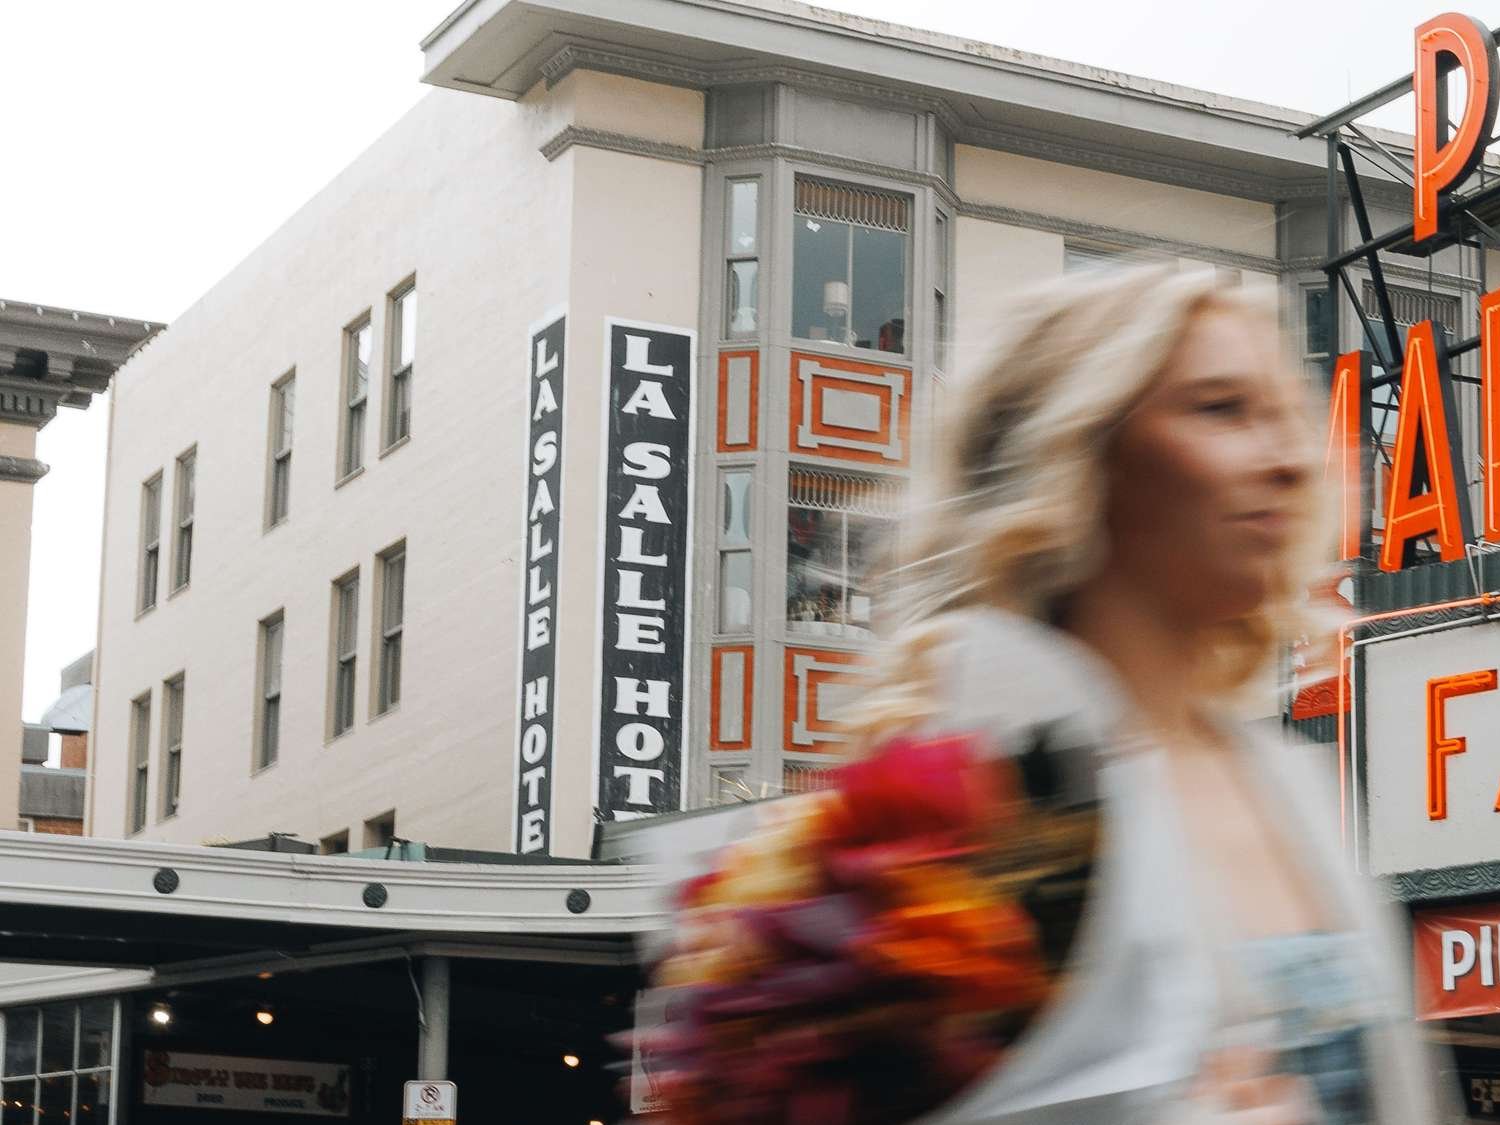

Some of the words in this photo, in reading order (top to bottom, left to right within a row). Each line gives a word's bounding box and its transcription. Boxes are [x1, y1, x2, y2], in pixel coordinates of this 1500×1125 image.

[532, 336, 559, 423] LA
[621, 333, 677, 421] LA
[527, 430, 558, 653] SALLE
[614, 441, 674, 655] SALLE
[612, 674, 673, 822] HOT
